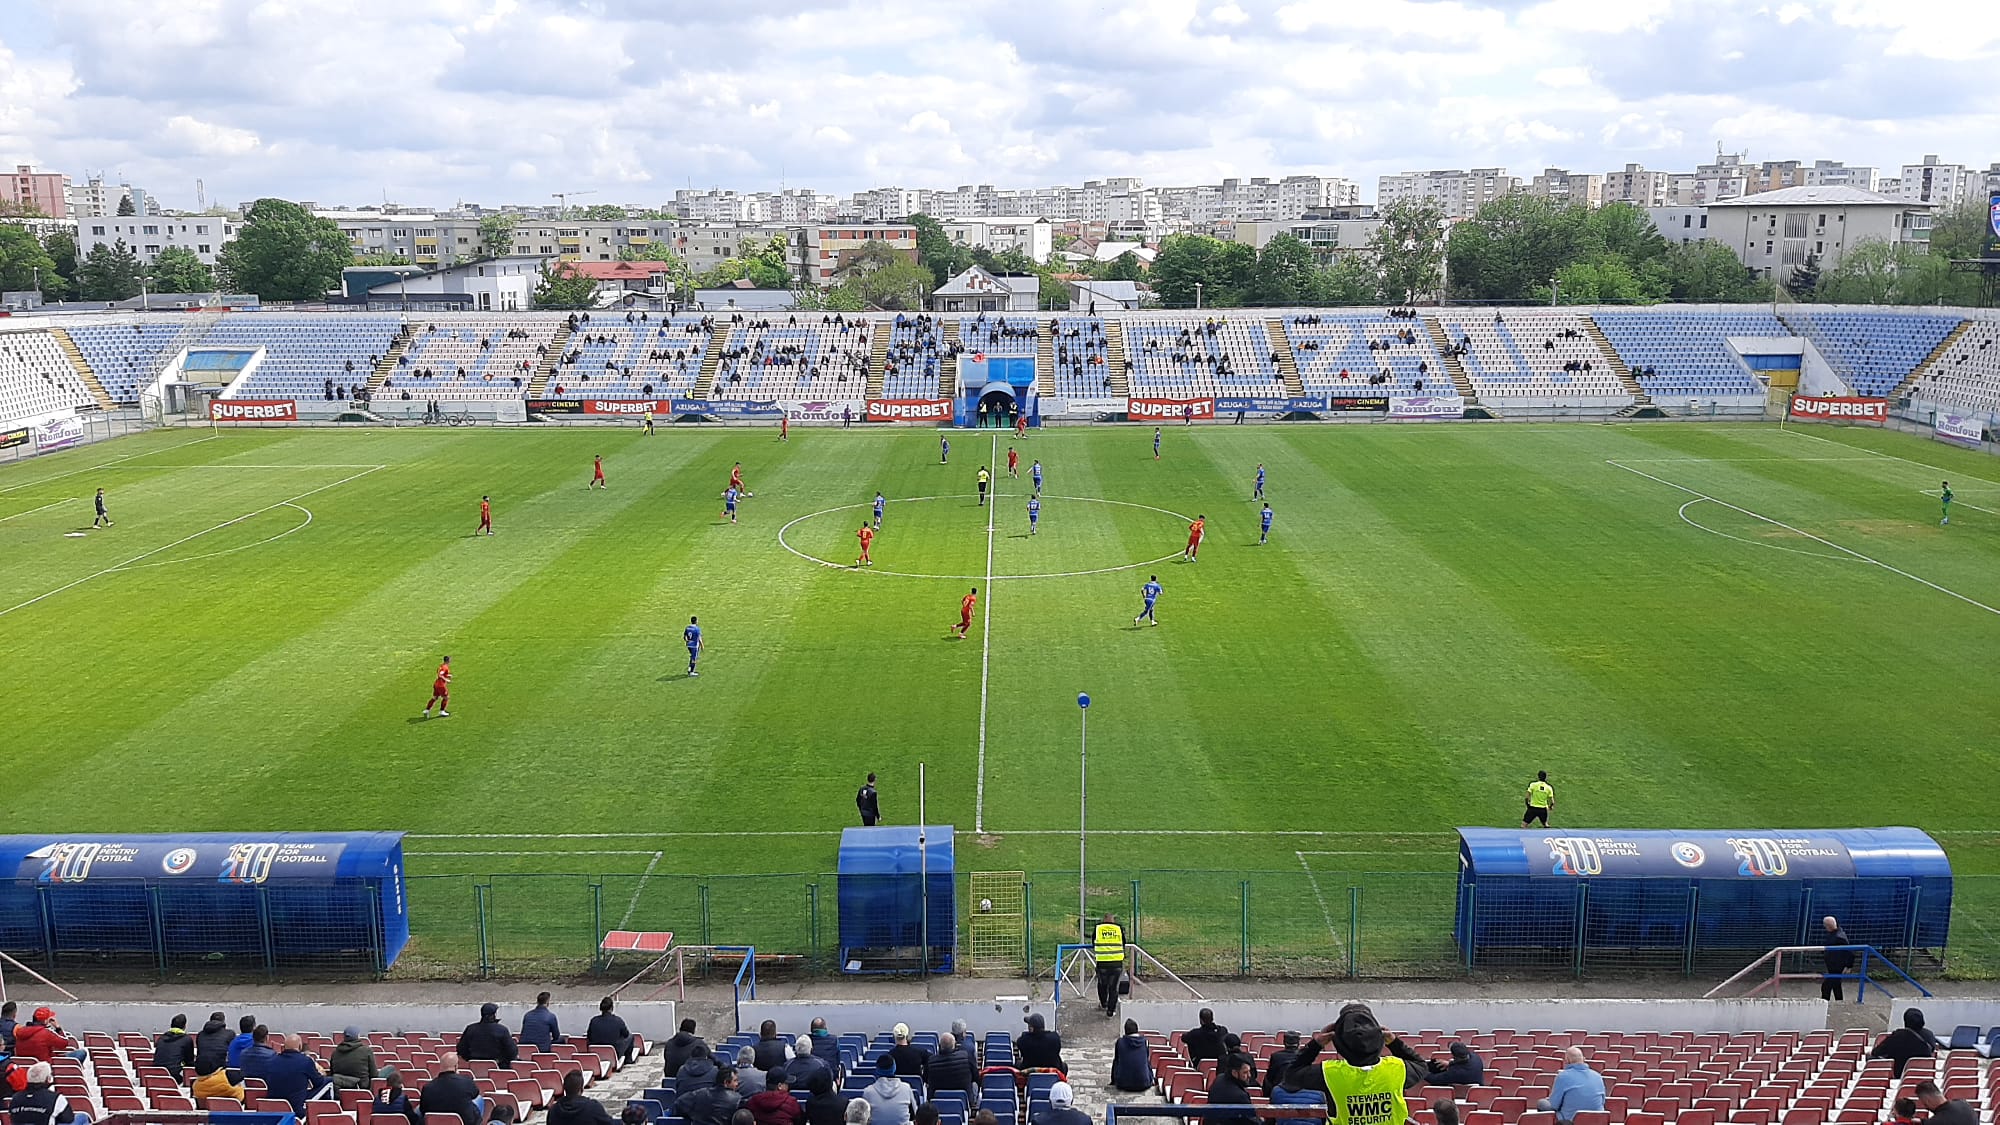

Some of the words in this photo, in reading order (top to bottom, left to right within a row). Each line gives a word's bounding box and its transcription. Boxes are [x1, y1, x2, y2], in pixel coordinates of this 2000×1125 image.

[213, 403, 294, 418] SUPERBET
[595, 401, 658, 413] SUPERBET
[675, 403, 701, 411] AZUGA
[756, 403, 778, 411] AZUG
[869, 402, 950, 417] SUPERBET
[1130, 400, 1212, 417] SUPERET
[1392, 404, 1460, 413] Romfour
[1794, 398, 1886, 416] SUPERBET
[38, 427, 82, 443] Romfour
[1937, 420, 1980, 439] Romfour
[95, 855, 136, 863] FOTBAL
[275, 855, 328, 863] FOOTBALL
[1346, 1092, 1392, 1104] STEWARD
[1347, 1101, 1392, 1117] WMC
[1348, 1113, 1392, 1125] SECURITY
